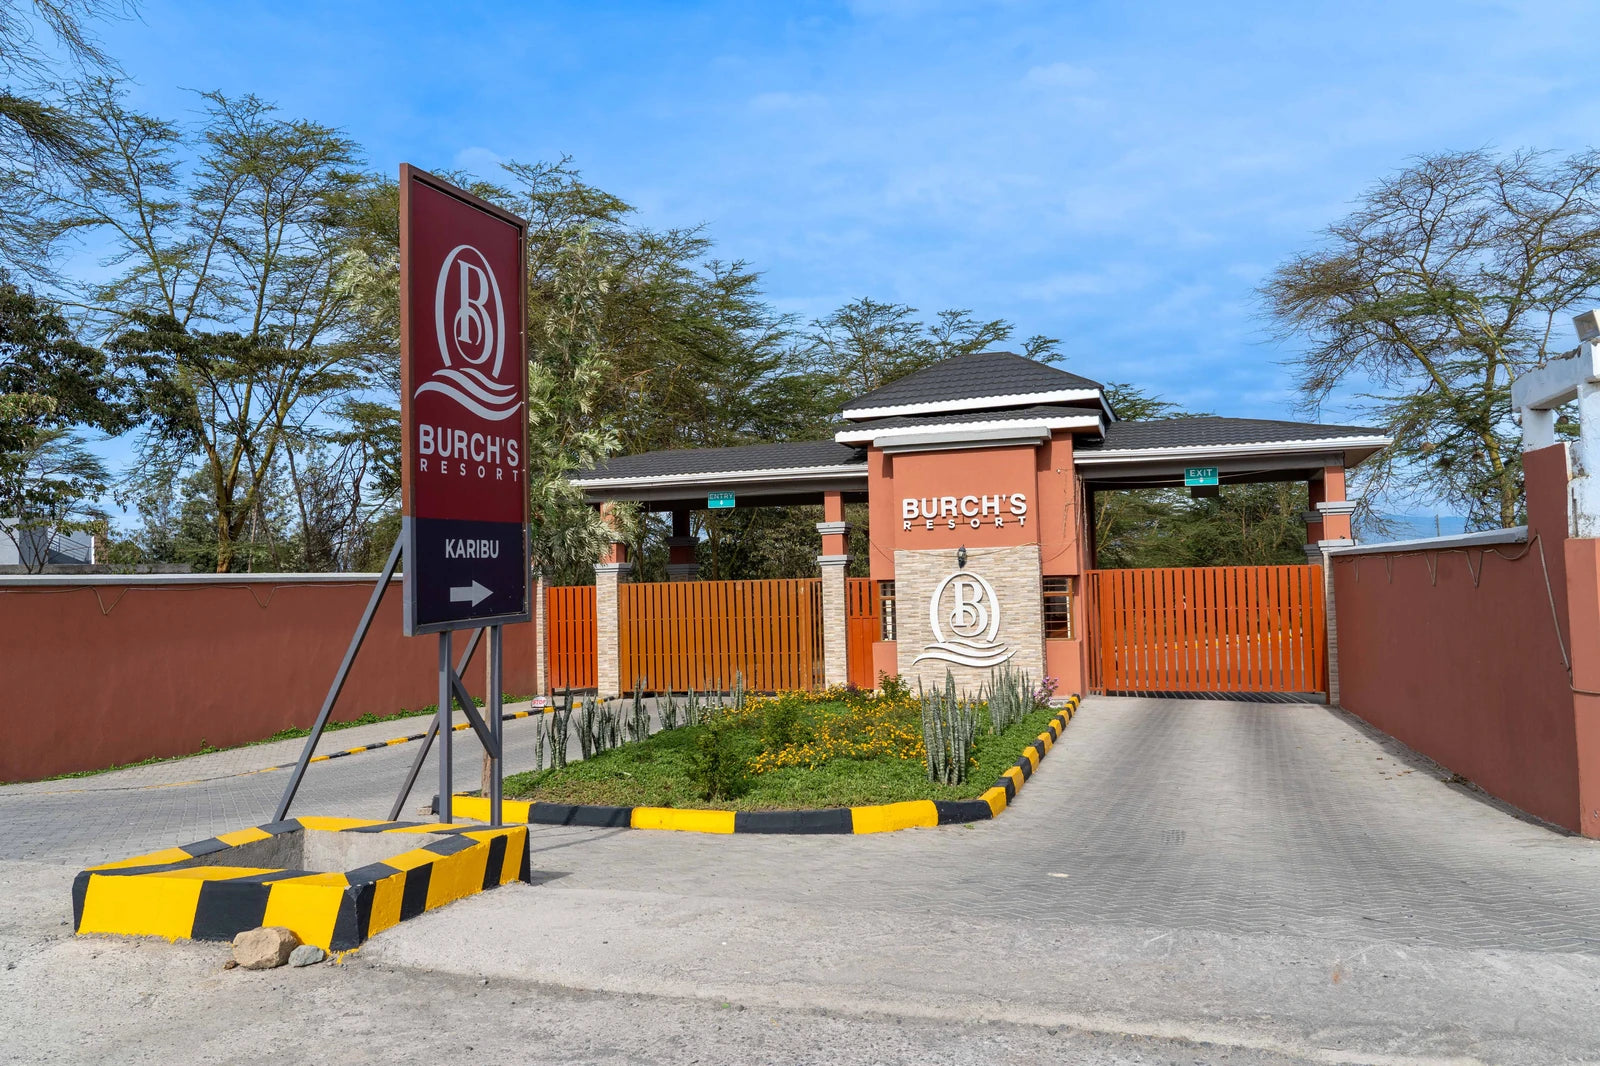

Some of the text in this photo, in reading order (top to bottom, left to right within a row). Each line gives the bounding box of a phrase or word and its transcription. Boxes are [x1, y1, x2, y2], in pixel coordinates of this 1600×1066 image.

[419, 424, 519, 467] BURCH'S
[420, 458, 518, 482] RESORT
[1190, 468, 1212, 476] EXIT
[902, 493, 1027, 520] BURCH'S
[903, 516, 1026, 531] RESORT
[445, 538, 499, 558] KARIBU
